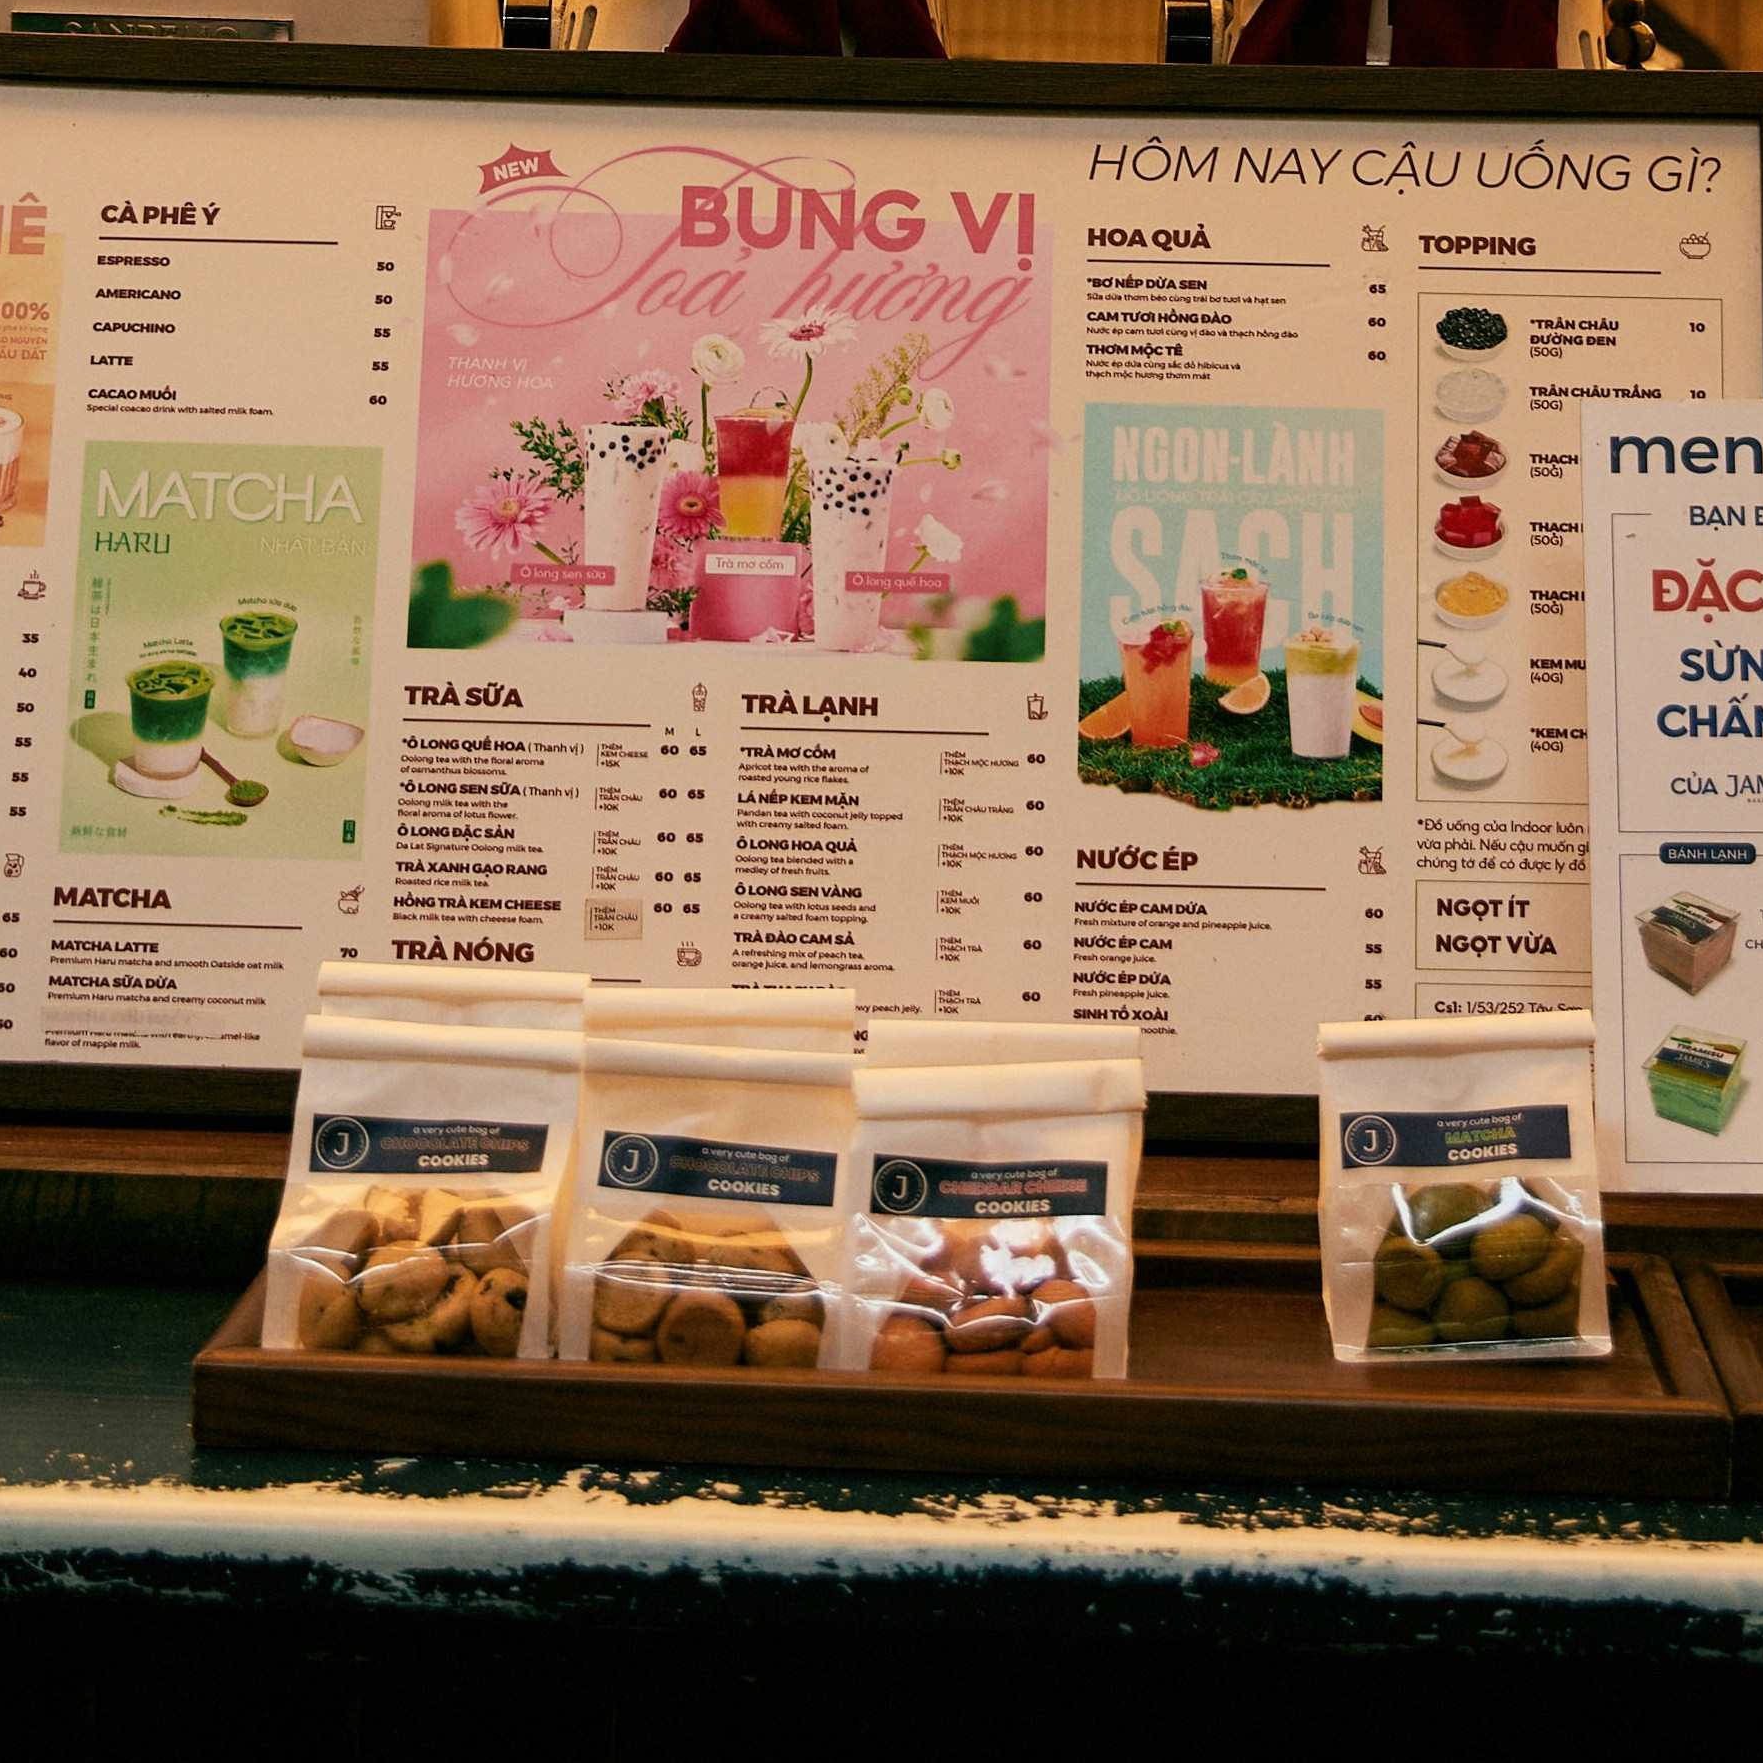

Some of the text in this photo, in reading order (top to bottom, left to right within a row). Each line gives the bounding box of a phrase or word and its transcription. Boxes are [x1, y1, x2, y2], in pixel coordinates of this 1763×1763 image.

[493, 157, 538, 181] NEW
[1090, 136, 1721, 194] HÔM NAY CẬU UỐNG GÌ?
[101, 200, 220, 225] CÀ PHÊ Ý
[680, 186, 1034, 272] BUNG VỊ
[1088, 223, 1211, 252] HOA QUẢ
[1419, 235, 1536, 256] TOPPING
[97, 255, 170, 267] ESPRESSO
[377, 262, 394, 271] 50
[93, 322, 175, 333] CAPUCHINO
[374, 328, 390, 338] 55
[1113, 421, 1354, 485] NGON-LÀNH
[96, 468, 364, 526] MATCHA
[1690, 506, 1745, 531] BẠN
[95, 532, 170, 554] HARU
[22, 633, 39, 643] 35
[404, 681, 523, 707] TRÀ SỮA
[741, 690, 878, 722] TRÀ LẠNH
[1671, 772, 1718, 795] CỦA
[1077, 845, 1198, 871] NƯỚC ÉP
[395, 877, 432, 886] Roasted
[1437, 895, 1530, 921] NGỌT ÍT
[1436, 931, 1557, 958] NGỌT VỪA
[1445, 1118, 1468, 1128] very
[1469, 1116, 1490, 1126] cute
[1492, 1114, 1510, 1124] bag
[1511, 1113, 1522, 1121] of
[1445, 1126, 1516, 1144] MATCHA
[418, 1154, 488, 1167] COOKIES
[1448, 1143, 1518, 1161] COOKIES
[708, 1179, 779, 1196] COOKIES
[975, 1199, 1050, 1214] COOKIES
